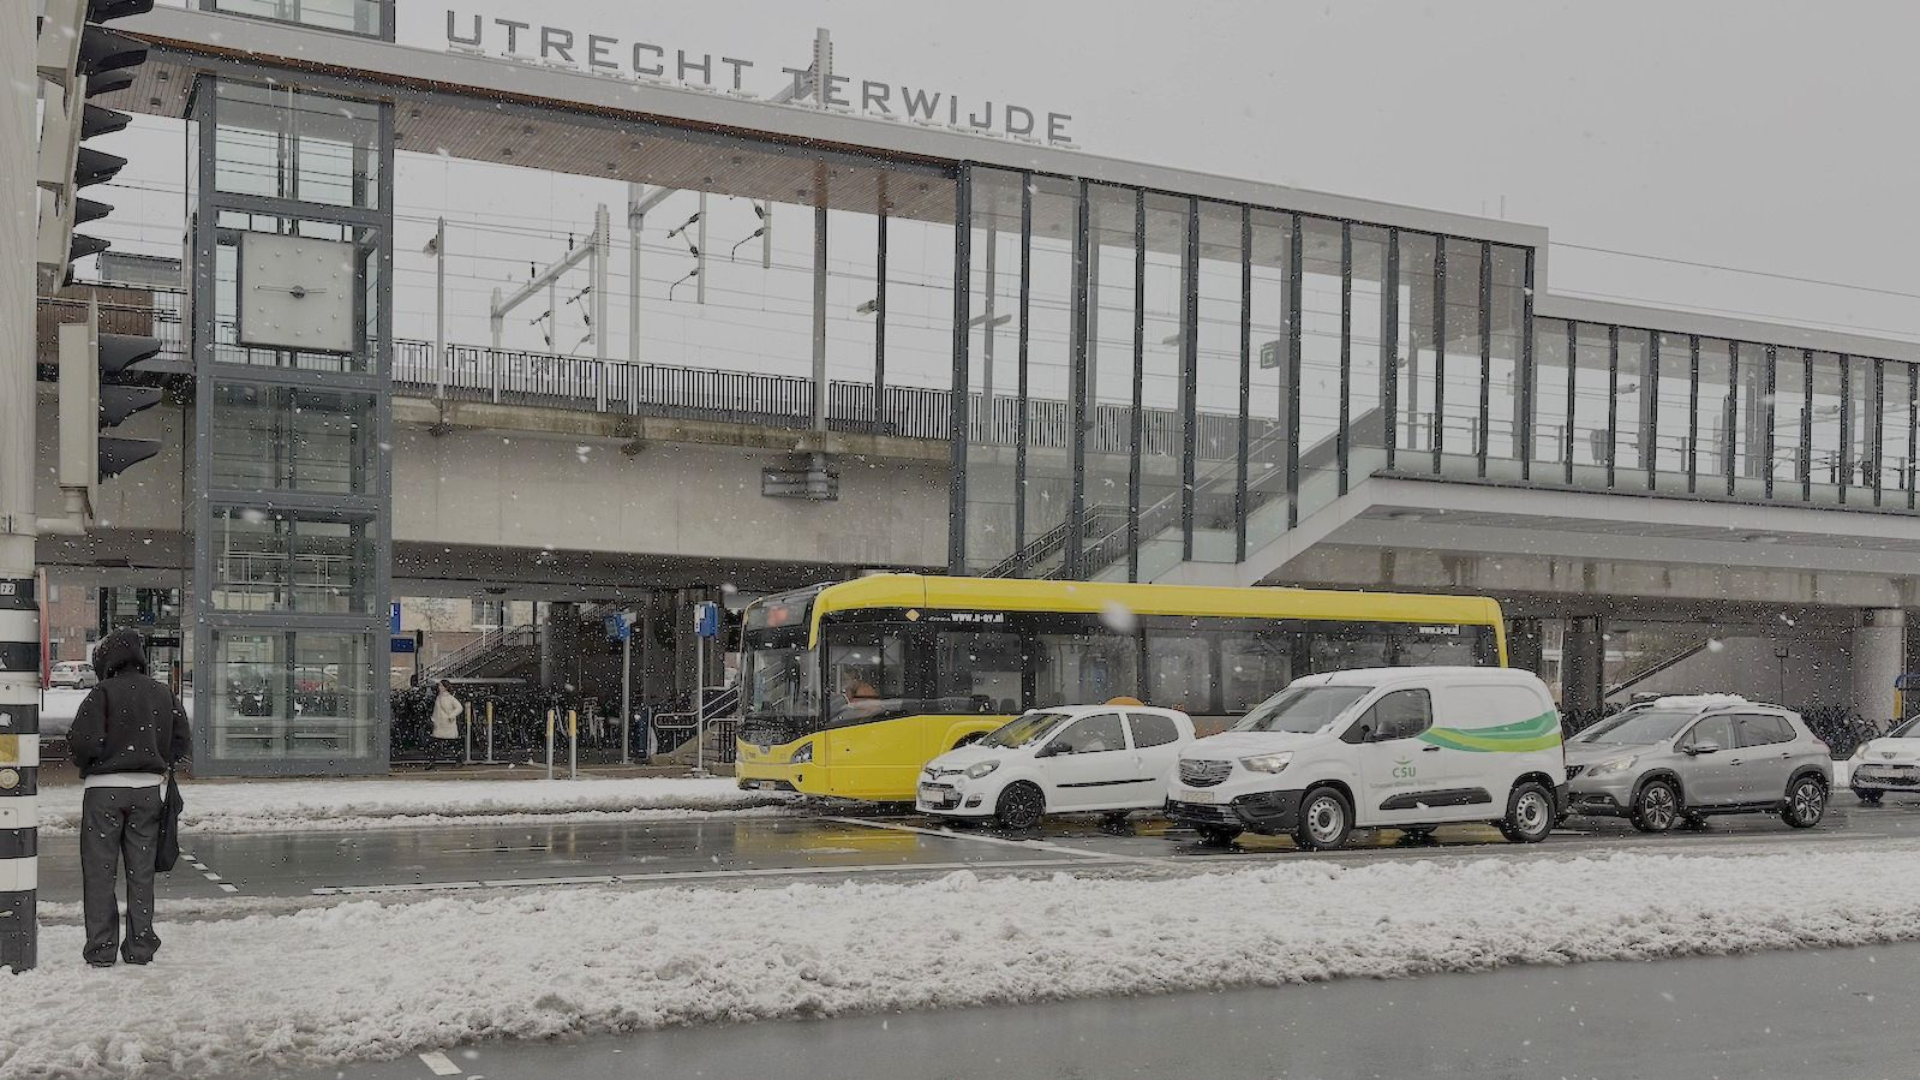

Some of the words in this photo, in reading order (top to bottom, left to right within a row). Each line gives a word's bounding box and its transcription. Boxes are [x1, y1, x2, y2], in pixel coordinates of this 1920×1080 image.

[447, 10, 753, 90] UTRECHT
[782, 67, 1072, 142] TERWIJDE
[1392, 767, 1416, 778] CSU
